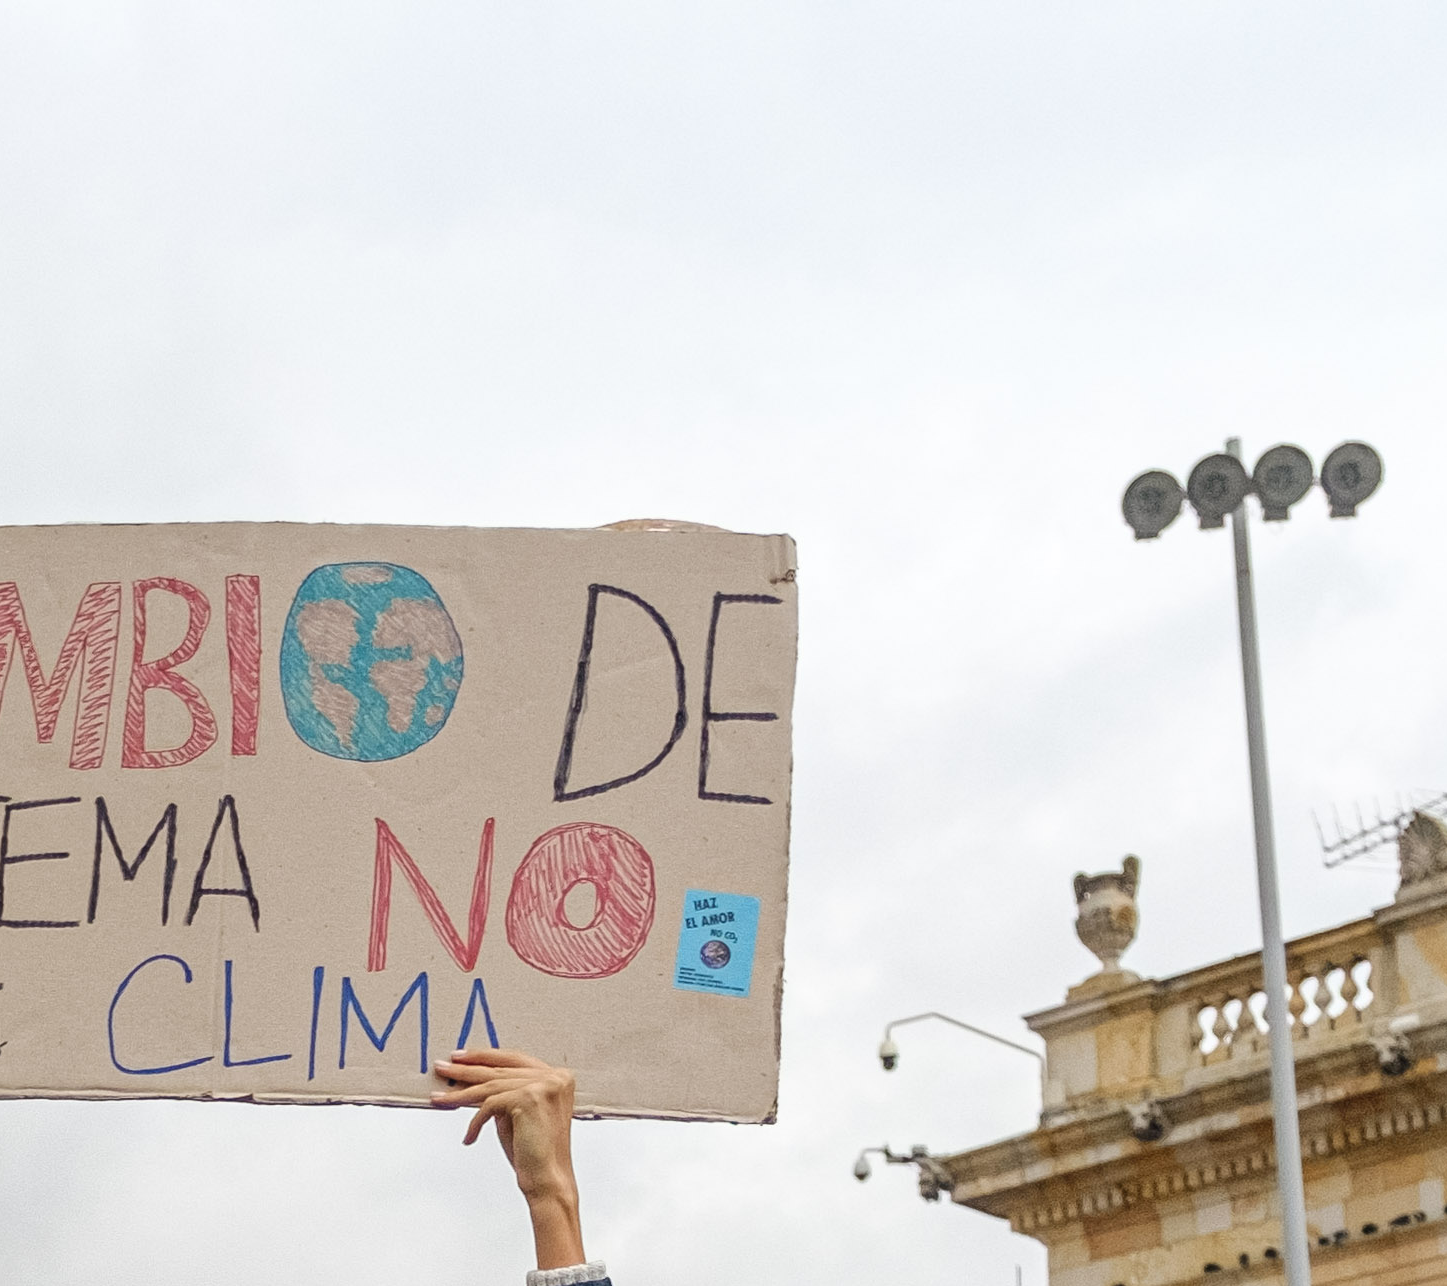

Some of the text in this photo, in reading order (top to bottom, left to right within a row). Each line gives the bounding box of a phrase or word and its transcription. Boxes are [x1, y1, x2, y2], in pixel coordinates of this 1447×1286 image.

[554, 584, 783, 803] DE
[368, 816, 657, 979] NO
[685, 911, 735, 929] EL AMOR
[693, 897, 718, 911] HAZ
[108, 953, 501, 1082] CLIMA
